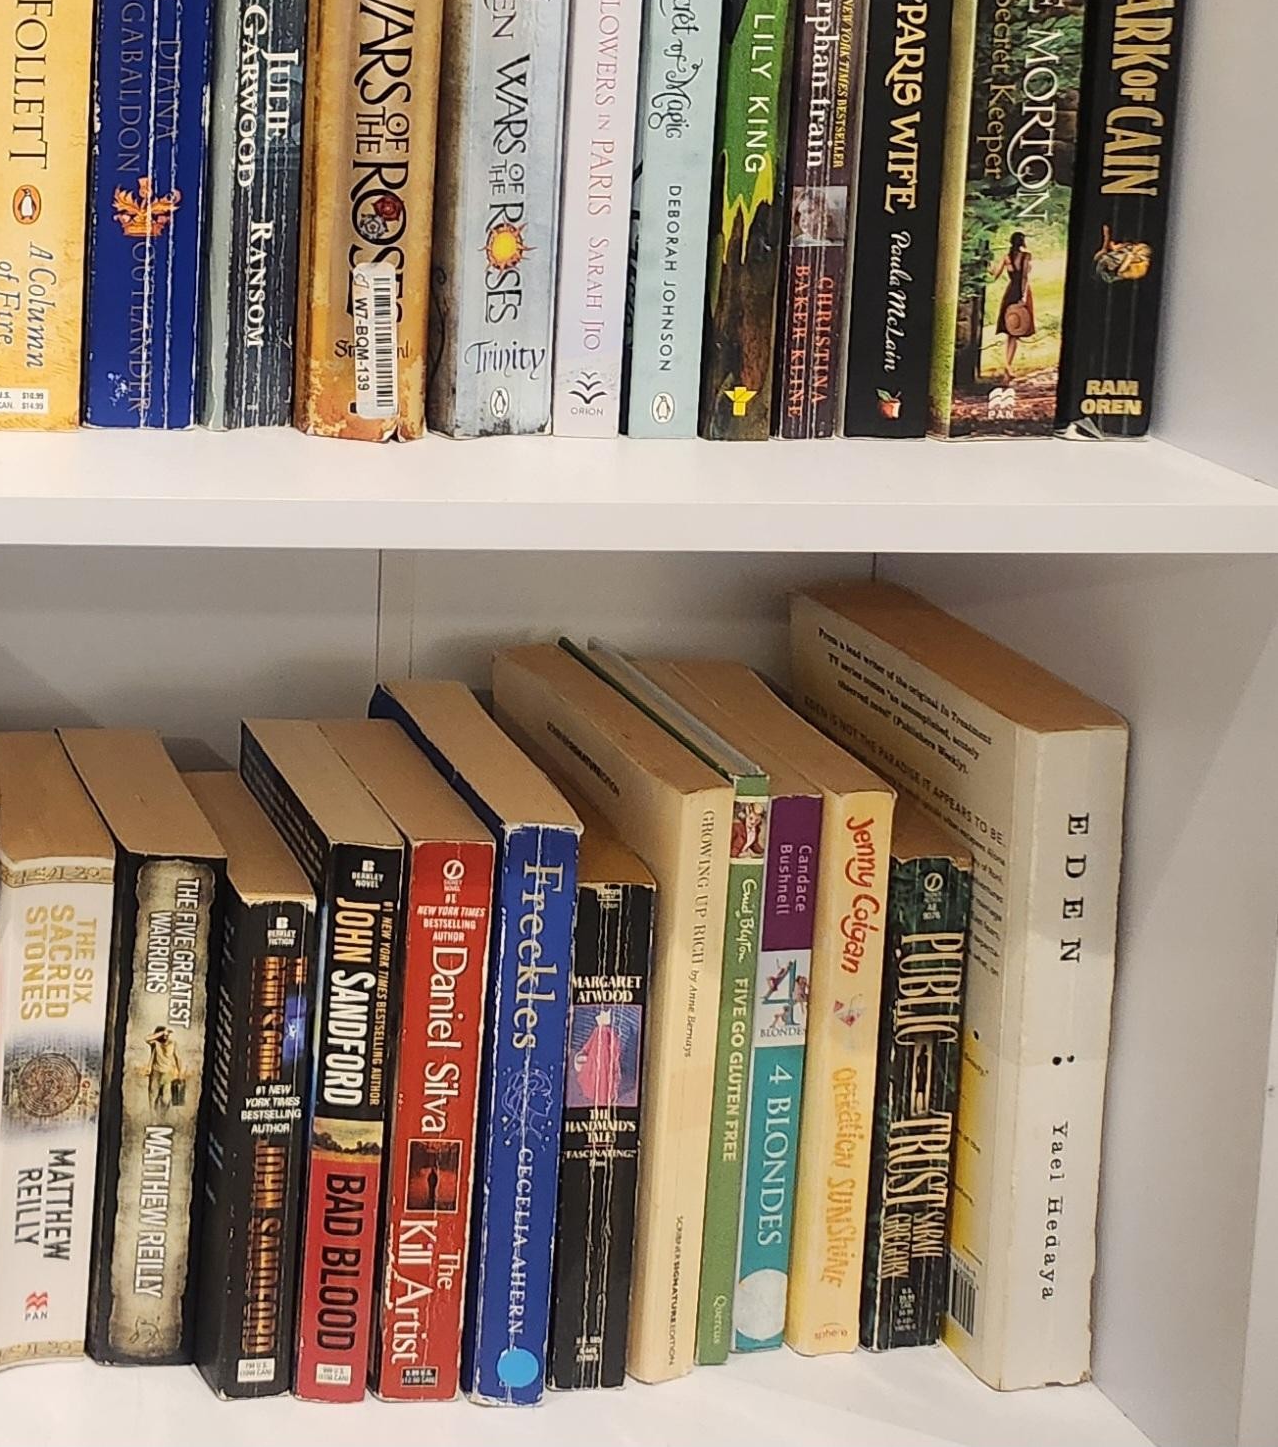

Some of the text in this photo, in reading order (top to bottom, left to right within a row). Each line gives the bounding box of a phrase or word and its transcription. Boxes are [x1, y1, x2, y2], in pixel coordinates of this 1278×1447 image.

[743, 13, 779, 175] LILY KING
[883, 112, 922, 214] WIFE
[25, 242, 57, 369] A Column
[245, 221, 272, 349] RANSOM
[660, 184, 681, 372] DEBORAH JOHNSON
[352, 295, 373, 393] W7-BQM-139
[464, 339, 546, 380] Trinity
[1086, 380, 1139, 397] RAM
[1080, 400, 1141, 416] OREN
[323, 898, 364, 1106] JOHN SANDFORD
[511, 862, 563, 1052] Freckles
[572, 975, 641, 988] MARGARET
[577, 989, 633, 1002] ATWOOD
[421, 946, 467, 1134] Daniel Silva
[15, 1167, 43, 1246] REILLY
[46, 1147, 76, 1262] MATTHEW
[759, 1063, 792, 1247] 4 BLONDES
[1042, 1122, 1072, 1302] Yael Hedaya
[317, 1172, 365, 1353] BAD BLOOD
